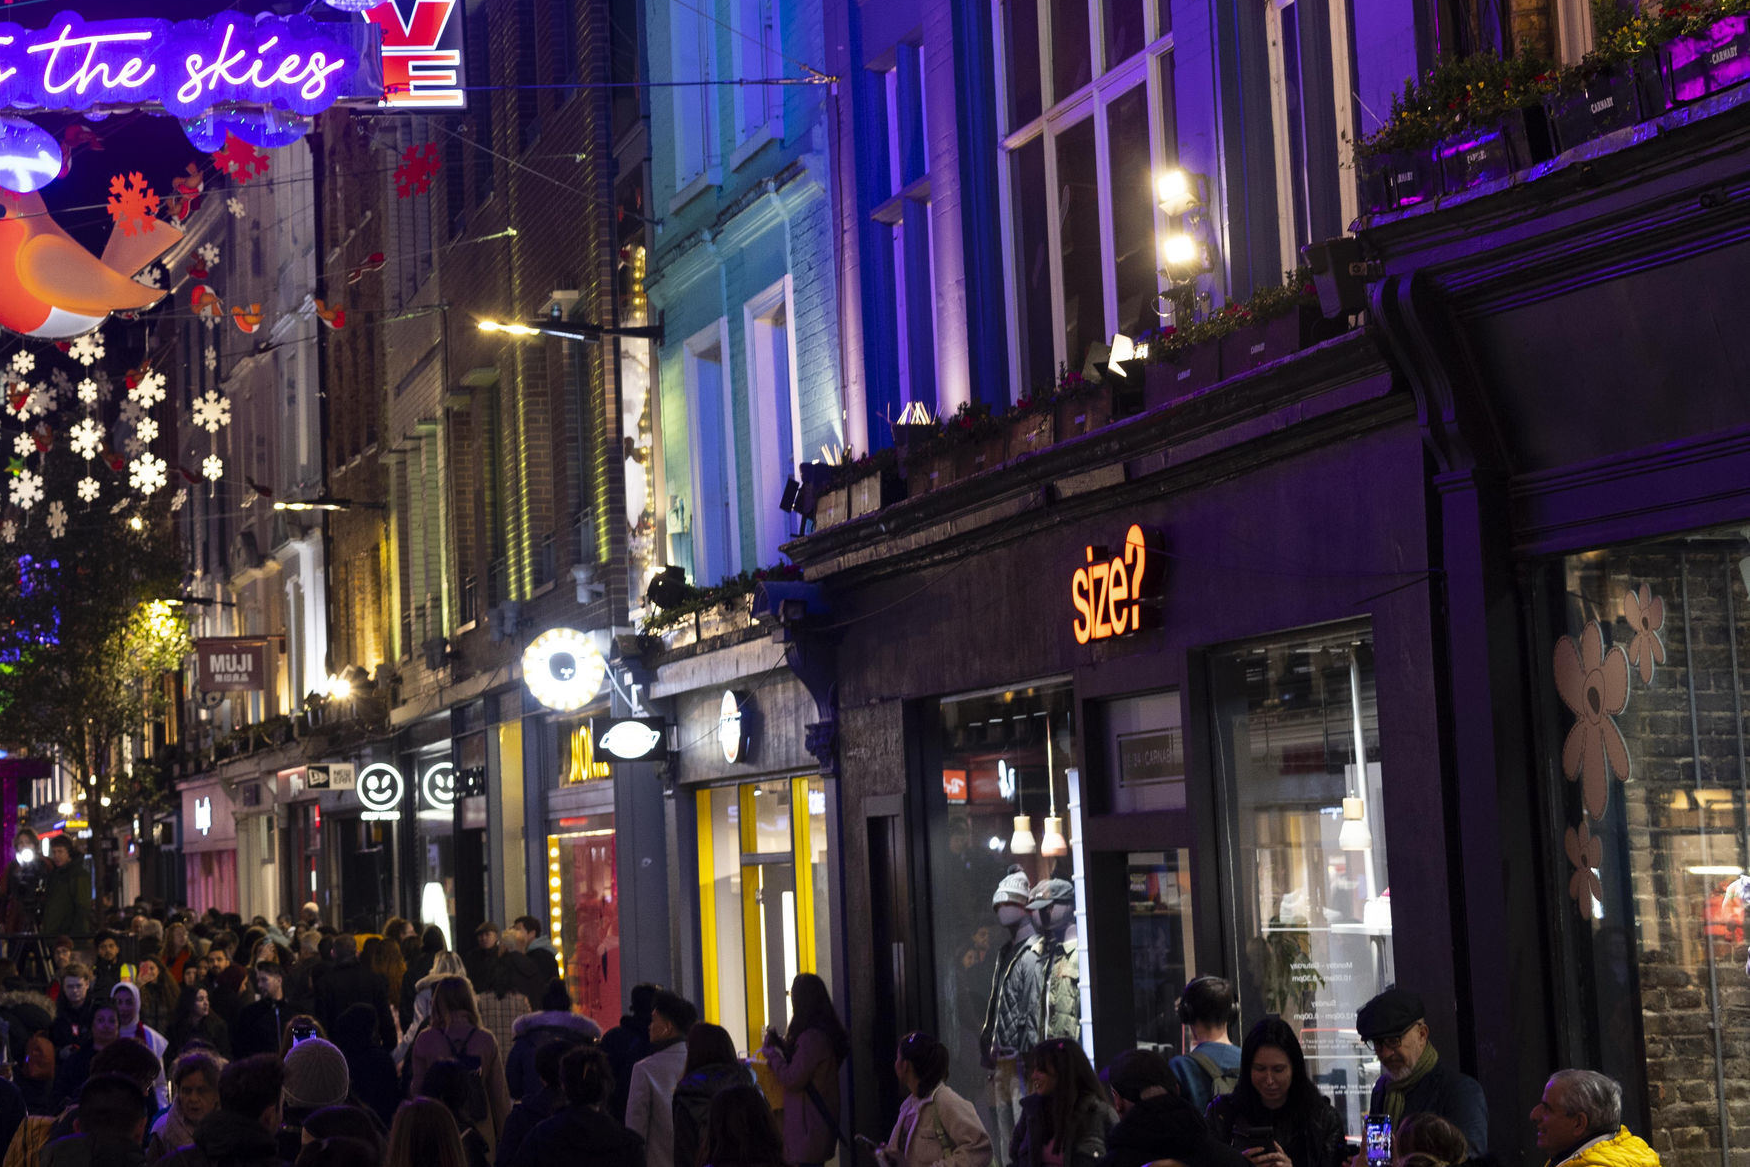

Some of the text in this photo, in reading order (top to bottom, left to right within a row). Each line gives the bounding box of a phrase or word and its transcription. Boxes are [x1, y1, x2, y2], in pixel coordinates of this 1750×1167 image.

[26, 23, 156, 95] the
[176, 23, 345, 105] skies
[1590, 96, 1615, 114] CARNABY
[1072, 523, 1146, 645] size?
[210, 653, 253, 673] MUJI
